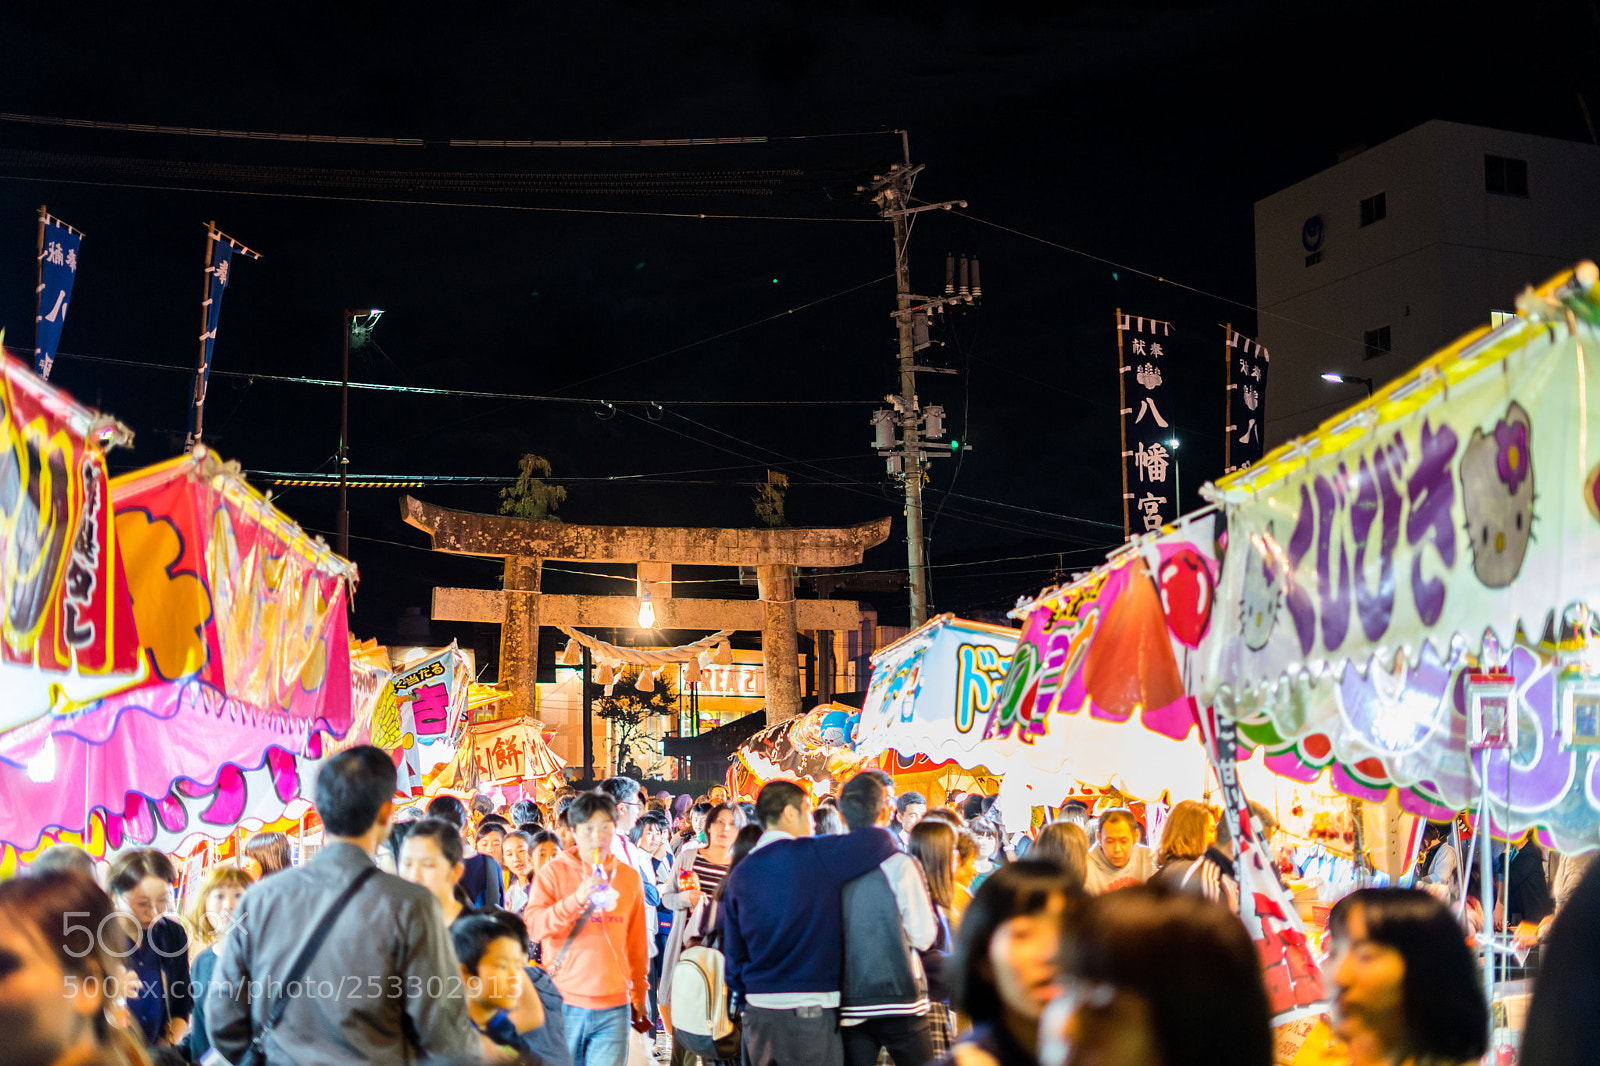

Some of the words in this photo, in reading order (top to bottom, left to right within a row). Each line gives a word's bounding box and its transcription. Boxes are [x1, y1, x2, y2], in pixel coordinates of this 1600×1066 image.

[1134, 397, 1170, 532] 八幡宮
[394, 661, 445, 692] く当たる
[955, 642, 1012, 734] ド
